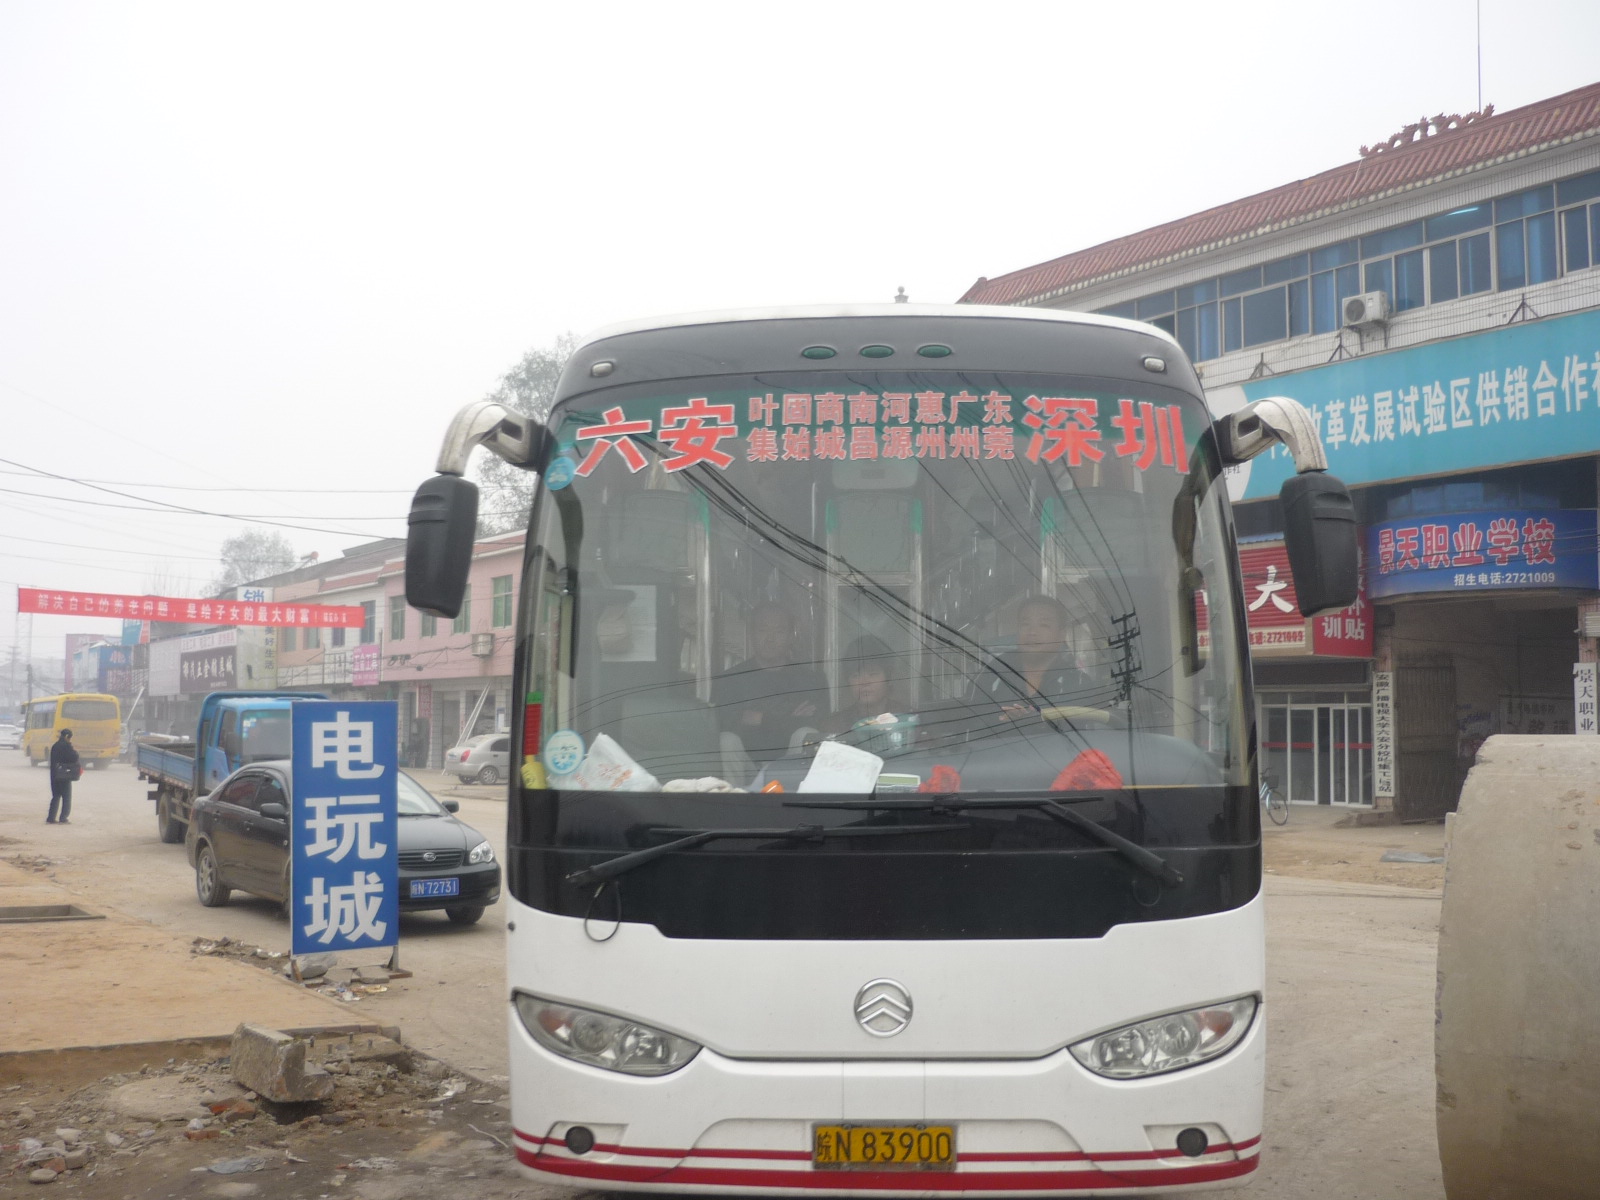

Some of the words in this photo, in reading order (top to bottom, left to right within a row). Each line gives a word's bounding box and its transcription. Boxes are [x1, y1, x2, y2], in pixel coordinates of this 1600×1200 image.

[575, 397, 738, 478] 六安
[1020, 394, 1191, 475] 深圳
[1270, 351, 1600, 460] 革发展试验区供销合作
[1378, 517, 1557, 575] 景天职业学校
[1453, 572, 1557, 587] 招生电话:2721009
[1248, 564, 1295, 613] 大
[1578, 668, 1595, 732] 景天职业
[303, 711, 388, 945] 电玩城
